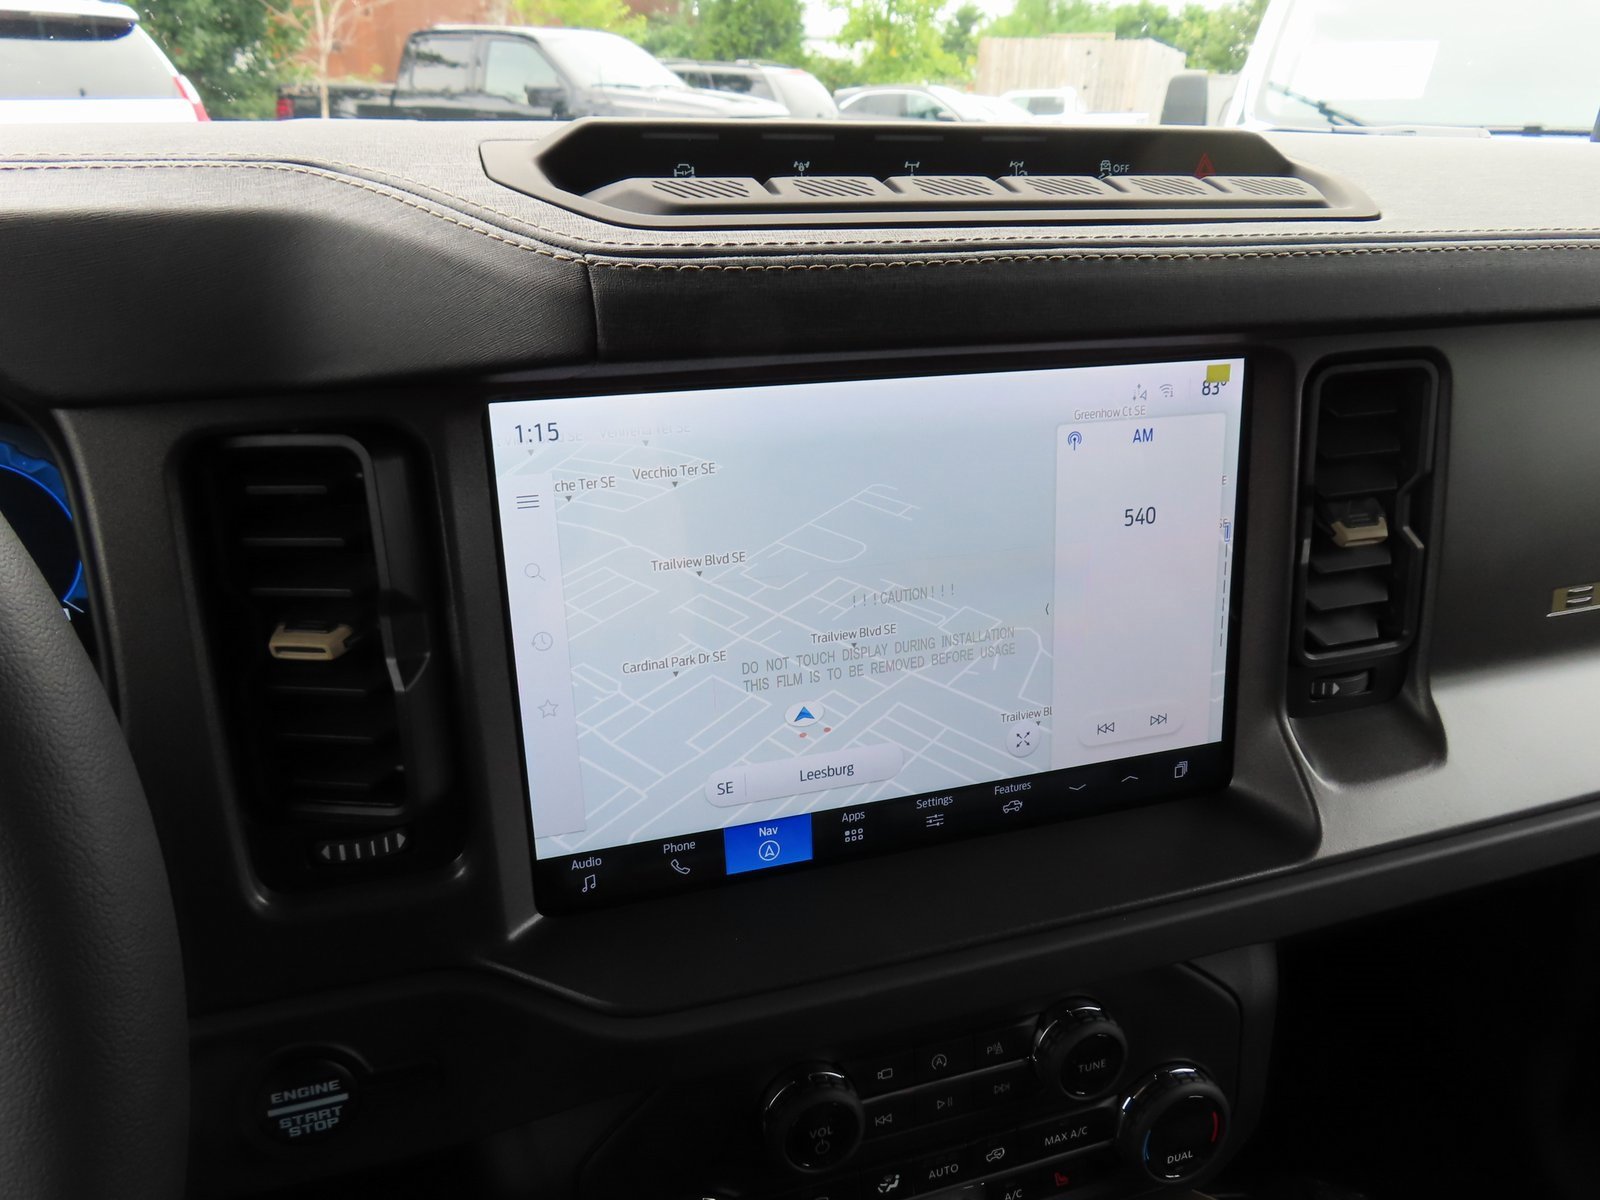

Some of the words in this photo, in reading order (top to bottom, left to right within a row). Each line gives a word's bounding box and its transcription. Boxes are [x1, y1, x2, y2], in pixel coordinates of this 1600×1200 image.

[1113, 164, 1130, 173] OFF
[1074, 407, 1121, 421] Greenhow
[1122, 406, 1133, 417] Ct
[1134, 404, 1146, 416] SE
[514, 421, 560, 444] 1:15
[1132, 427, 1154, 444] AM
[631, 466, 679, 481] Vecchio
[679, 464, 699, 477] Ter
[701, 462, 716, 475] SE
[578, 476, 598, 490] Ter
[600, 474, 616, 488] SE
[1123, 505, 1157, 527] 540
[650, 556, 703, 573] Trailview
[704, 553, 729, 567] Blvd
[731, 551, 746, 564] SE
[810, 629, 858, 645] Trailview
[859, 626, 882, 640] Blvd
[883, 623, 897, 636] SE
[741, 660, 760, 676] DO
[765, 657, 790, 673] NOT
[796, 651, 836, 669] TOUCH
[841, 643, 888, 663] DISPLAY
[894, 636, 936, 655] DURING
[941, 627, 1016, 648] INSTALLATION
[621, 659, 669, 675] Cardinal
[671, 656, 696, 670] Park
[698, 653, 712, 666] Dr
[712, 650, 727, 663] SE
[743, 676, 770, 693] THIS
[776, 672, 803, 689] FILM
[809, 670, 821, 684] IS
[827, 667, 843, 681] TO
[848, 664, 866, 678] BE
[870, 655, 925, 676] REMOVED
[931, 647, 975, 667] BEFORE
[979, 641, 1017, 660] USAGE
[1000, 708, 1042, 724] Trailview
[716, 780, 735, 796] SE
[798, 762, 855, 783] Leesburg
[993, 781, 1032, 796] Features
[915, 794, 954, 810] Settings
[841, 810, 866, 825] Apps
[758, 825, 779, 838] Nav
[662, 840, 697, 855] Phone
[570, 855, 602, 871] Audio
[1077, 1058, 1107, 1074] TUNE
[270, 1080, 341, 1104] ENGINE
[280, 1106, 343, 1129] START
[289, 1118, 340, 1137] STOP
[808, 1124, 834, 1141] VOL
[1044, 1133, 1069, 1148] MAX
[1069, 1125, 1089, 1141] A/C
[1166, 1149, 1195, 1166] DUAL
[927, 1162, 961, 1181] AUTO
[1003, 1187, 1024, 1200] A/C
